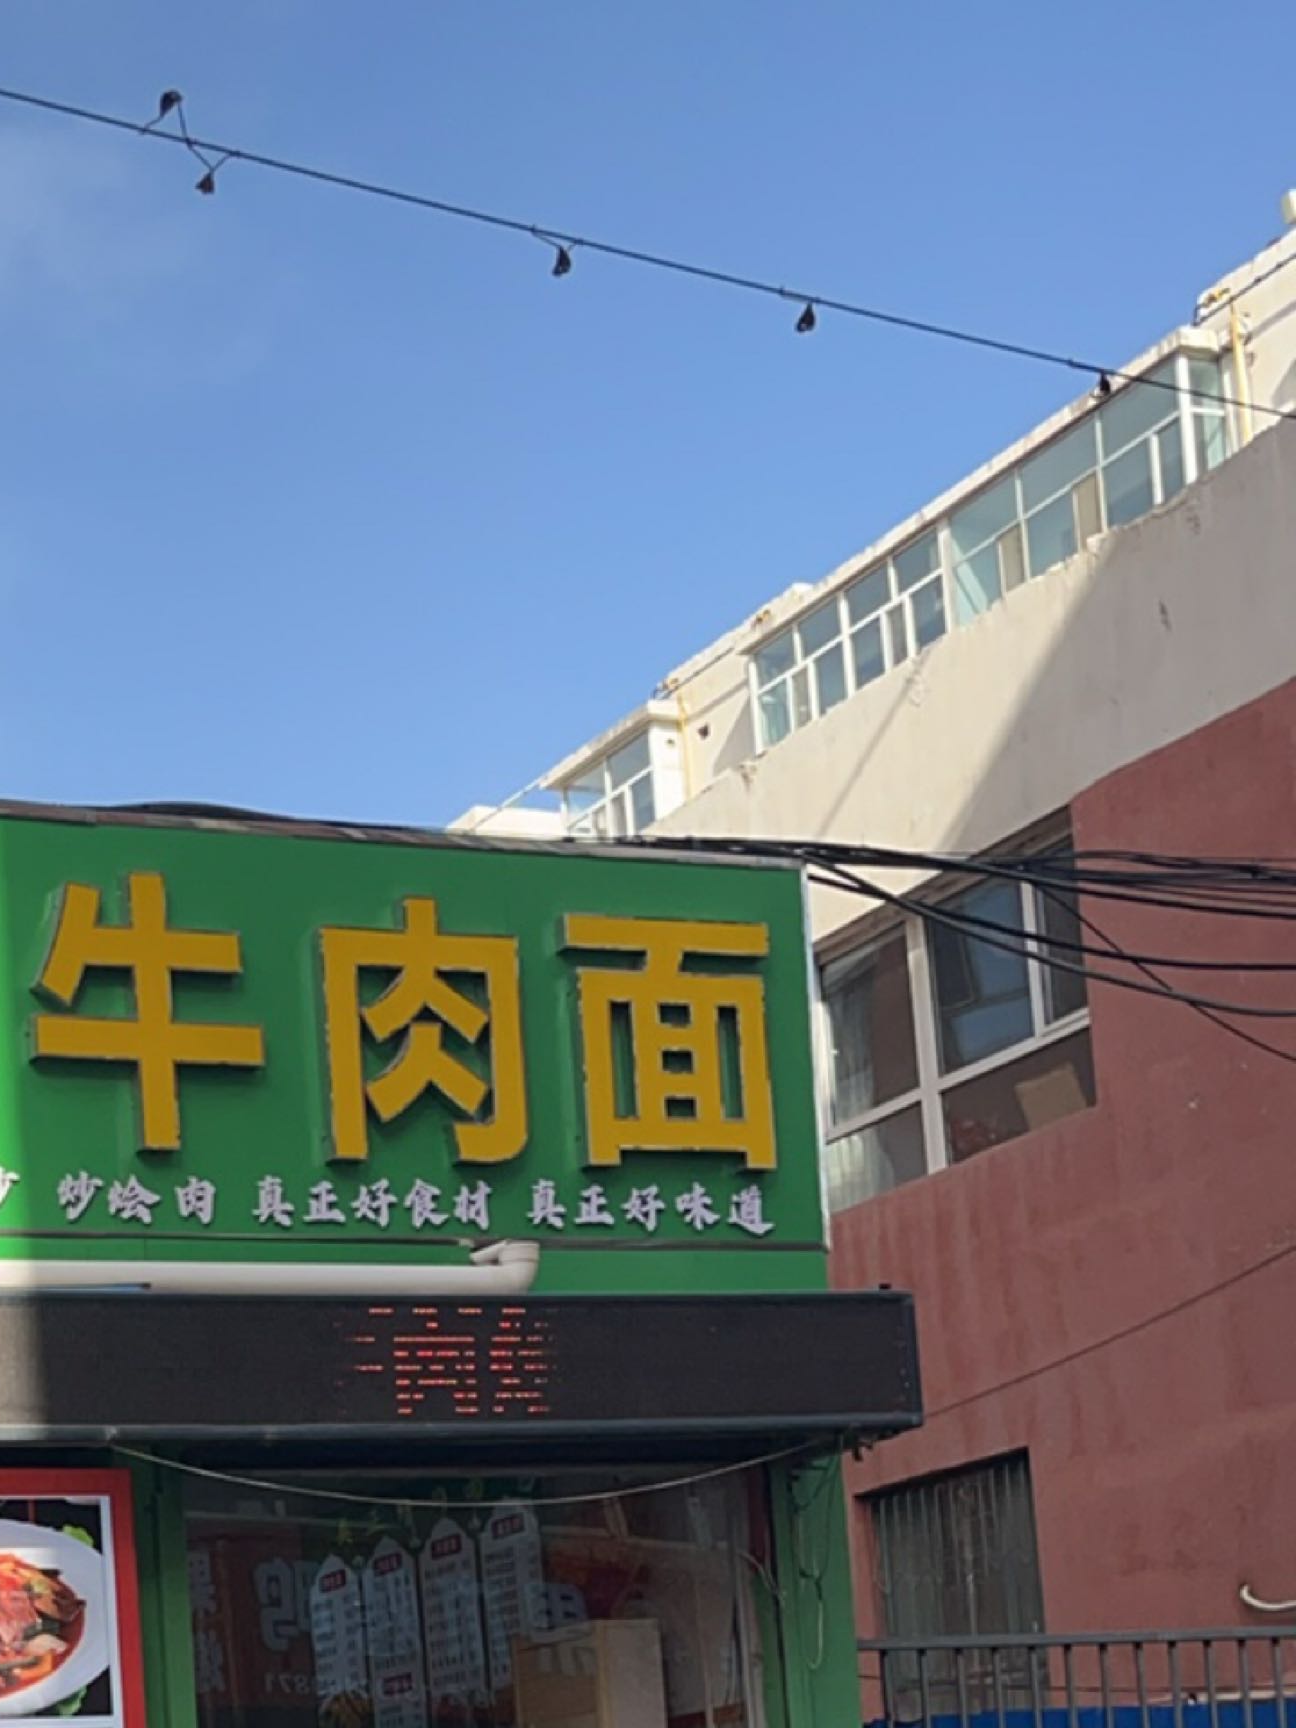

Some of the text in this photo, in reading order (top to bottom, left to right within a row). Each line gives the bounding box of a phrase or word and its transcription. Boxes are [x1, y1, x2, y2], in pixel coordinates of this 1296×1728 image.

[253, 1175, 493, 1231] 真正好食材
[527, 1178, 776, 1236] 真正好味道
